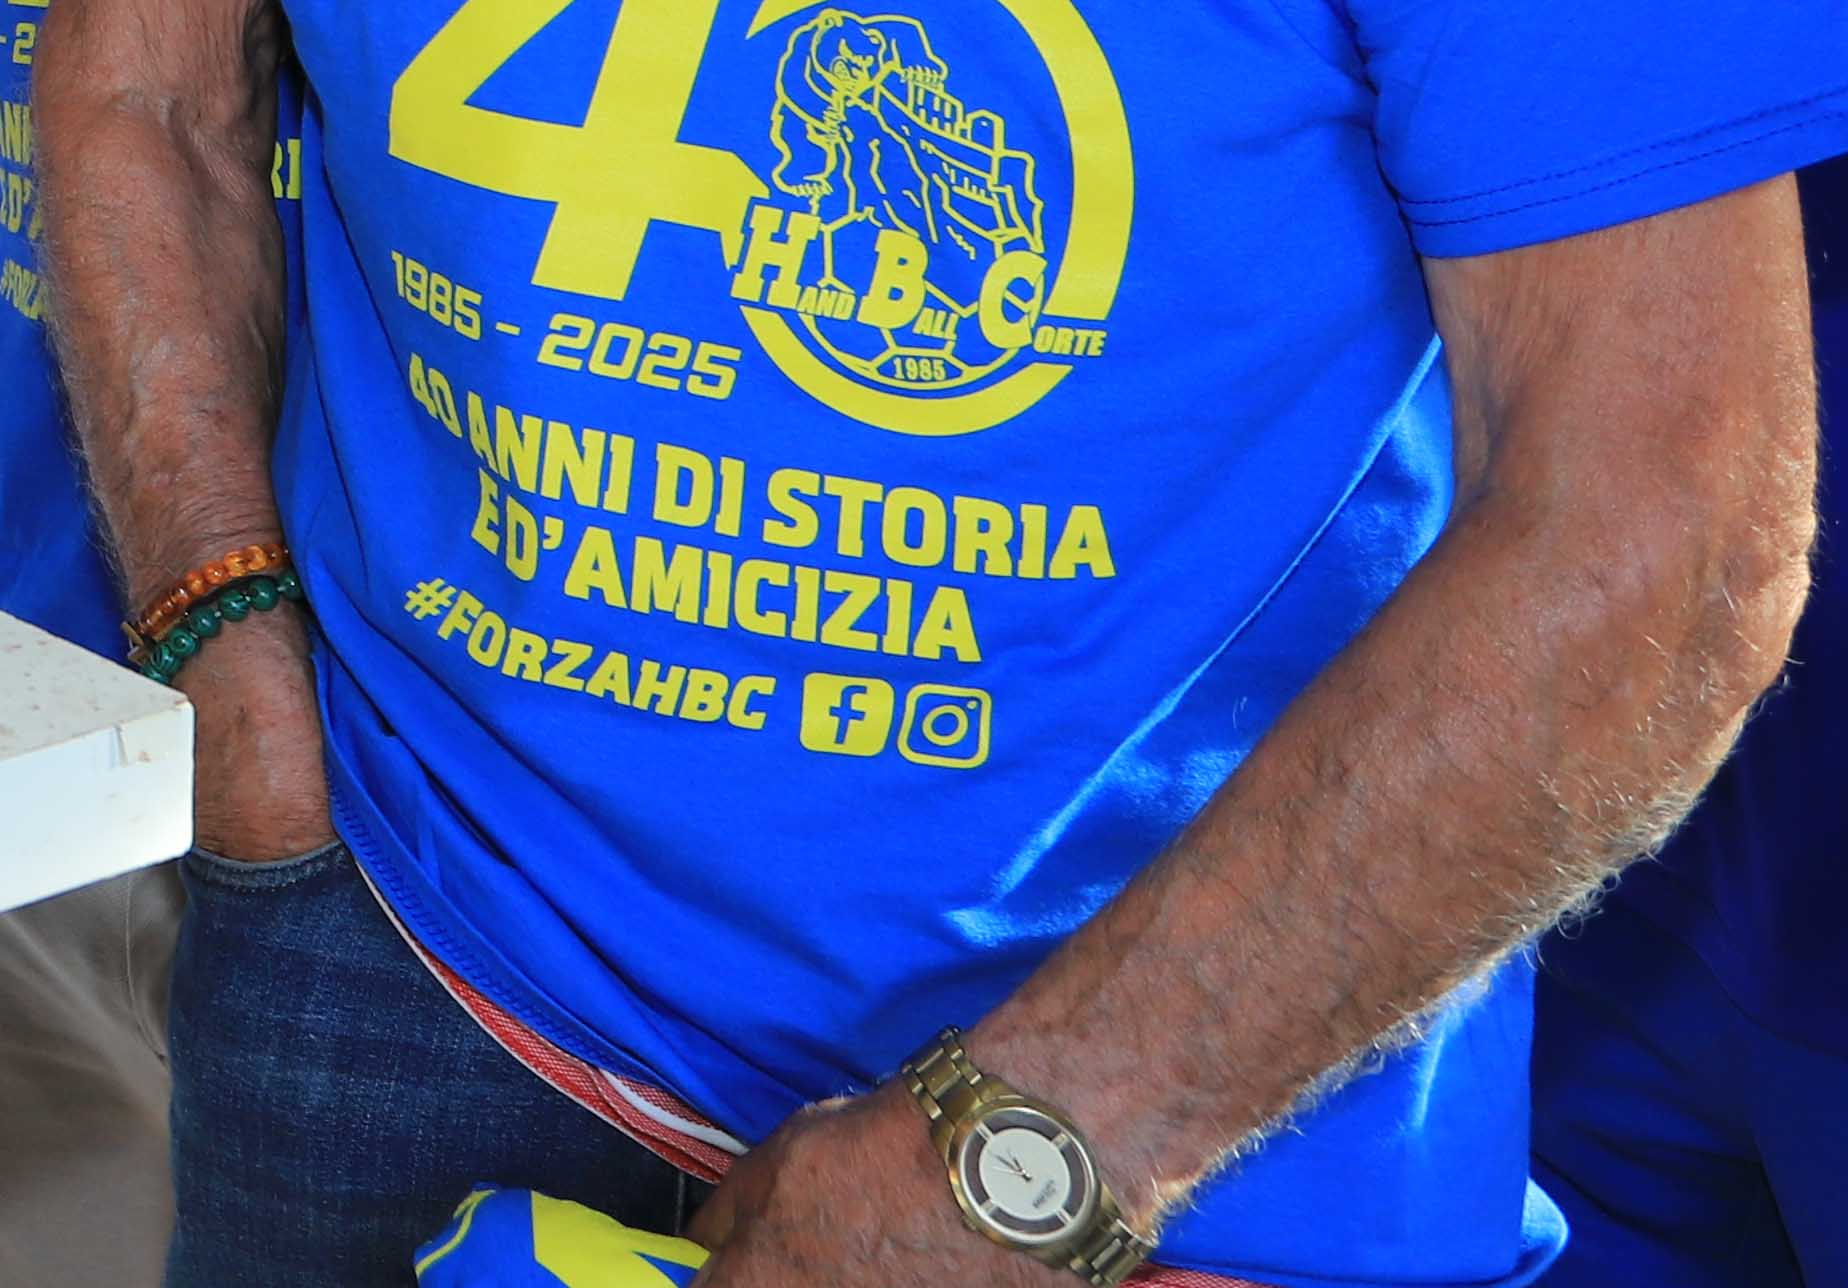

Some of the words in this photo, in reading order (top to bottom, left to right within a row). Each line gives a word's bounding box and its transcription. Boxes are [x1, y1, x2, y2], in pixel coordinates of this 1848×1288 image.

[391, 249, 483, 342] 1985
[537, 311, 742, 401] 2025
[892, 357, 947, 381] 1985
[409, 352, 463, 439] 40
[467, 390, 635, 515] ANNI
[653, 442, 746, 538] DI
[762, 467, 1116, 580] STORIA
[404, 577, 777, 731] #FORZAHBC
